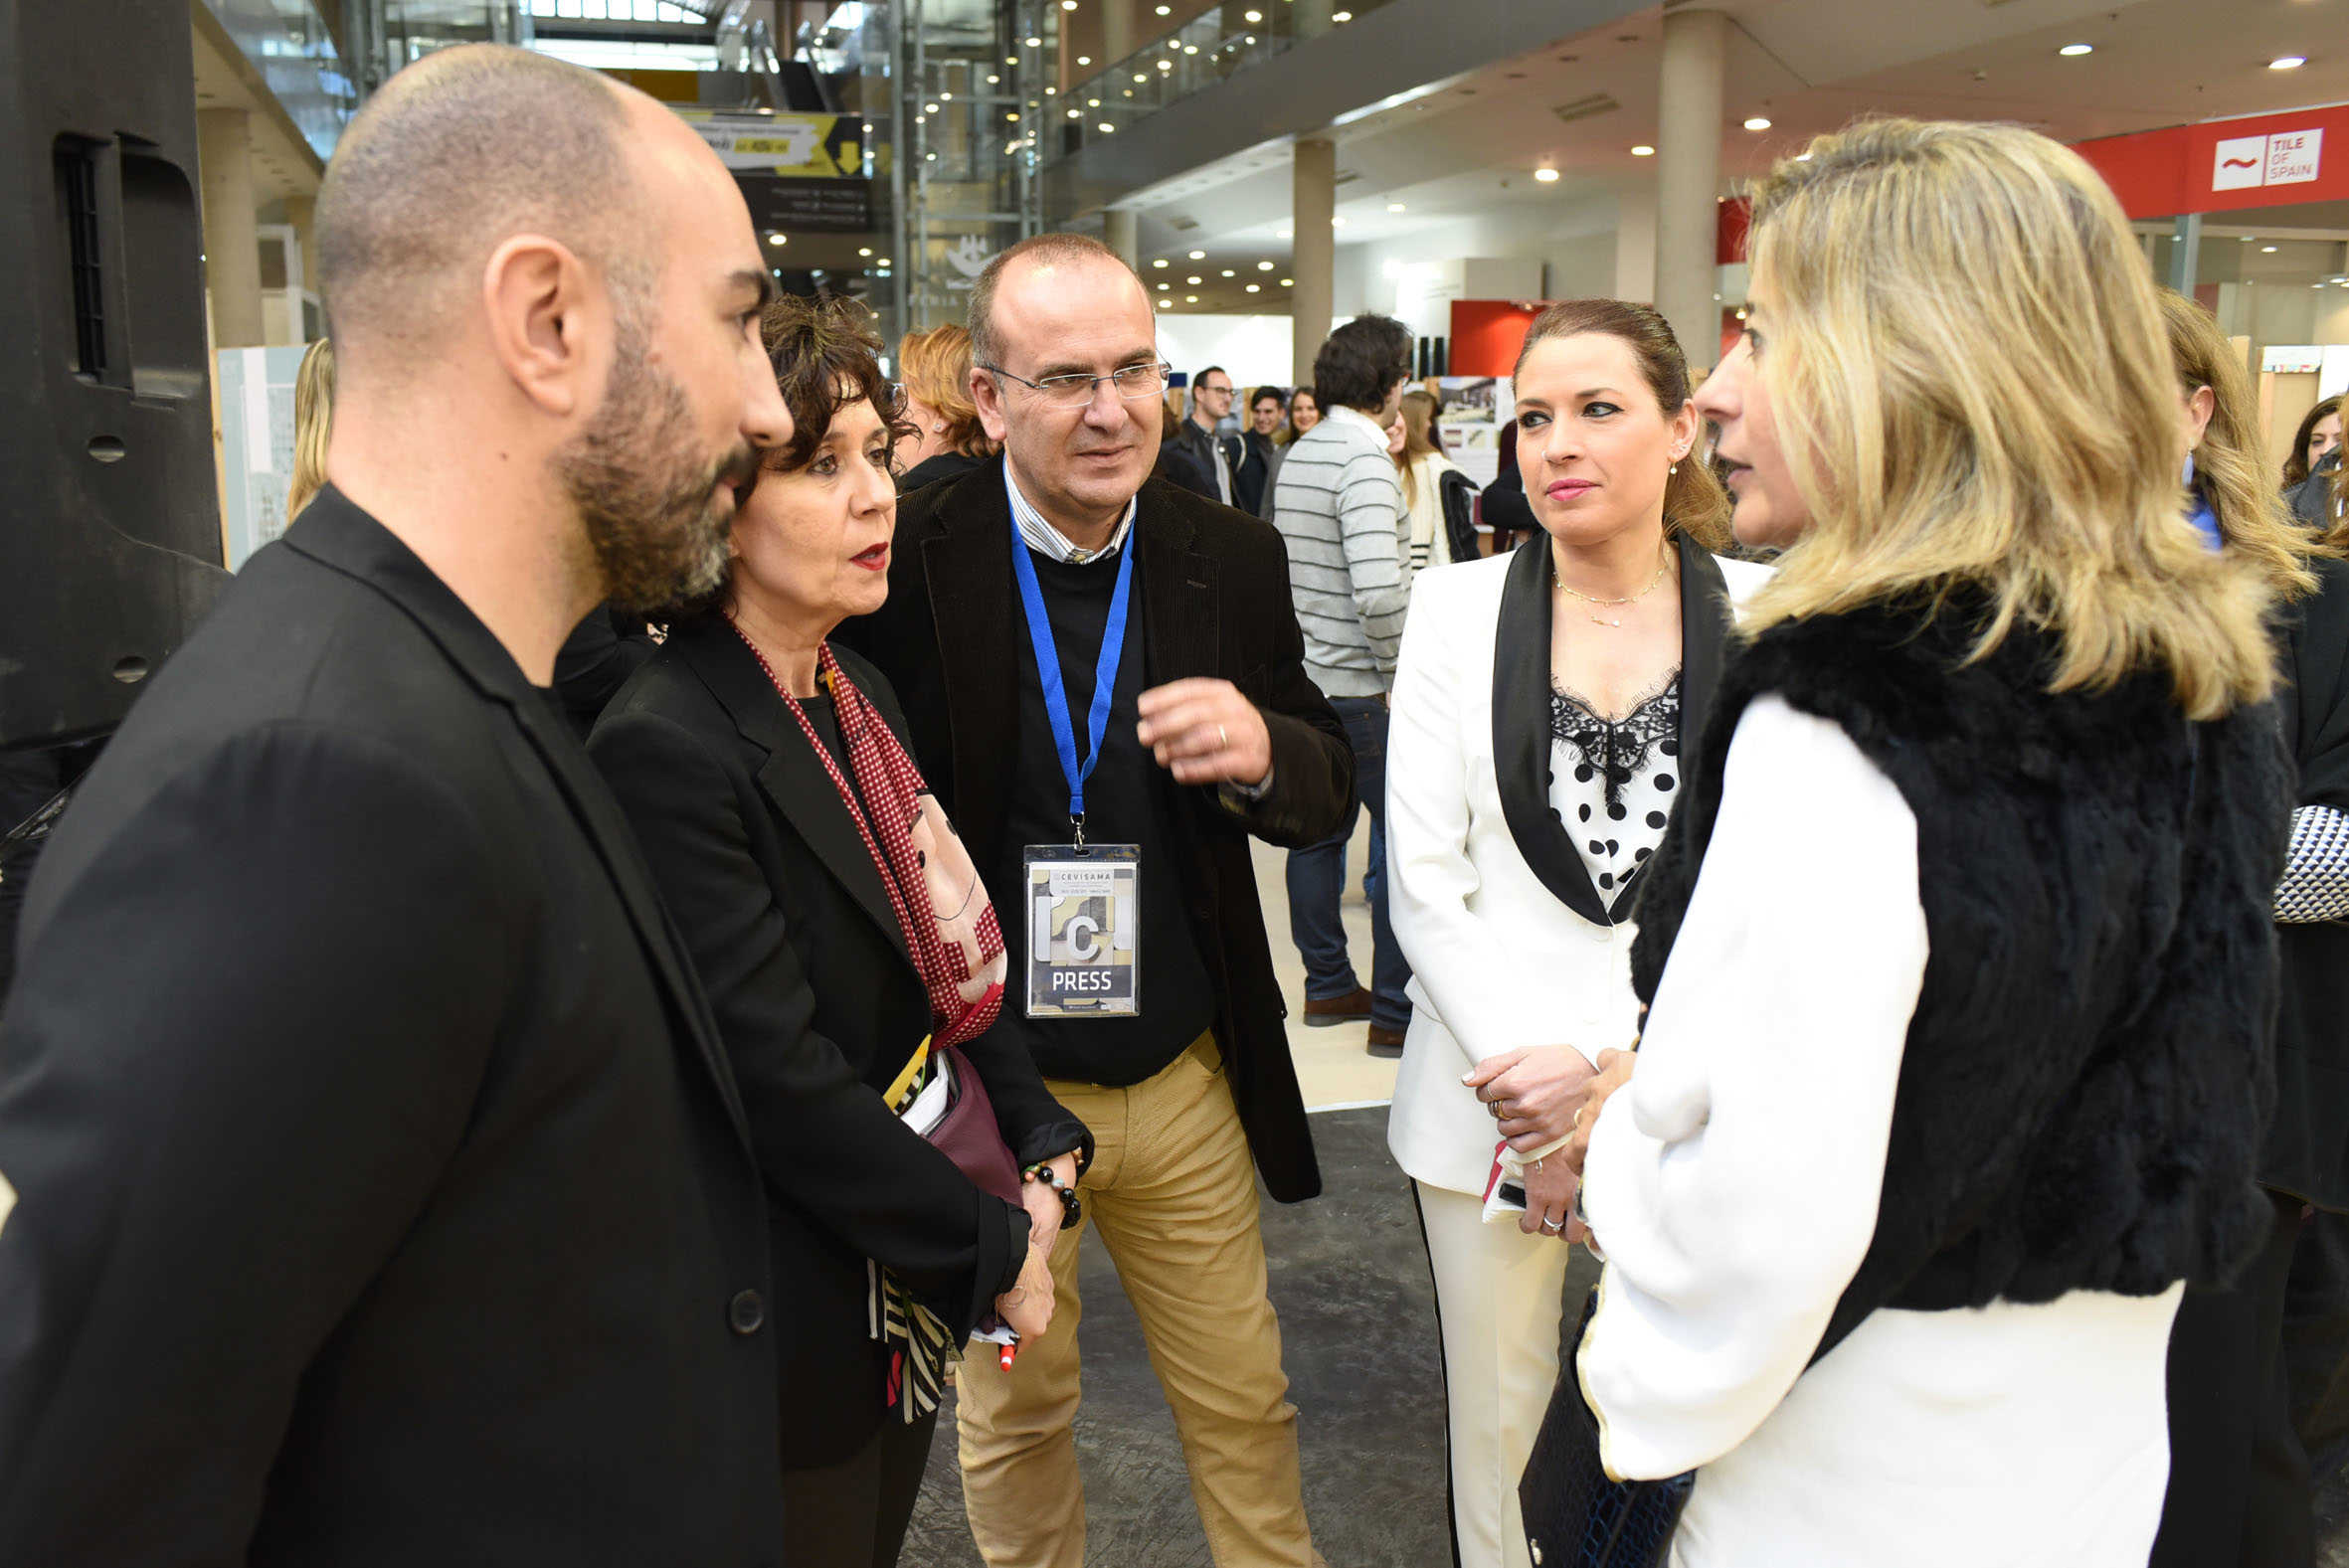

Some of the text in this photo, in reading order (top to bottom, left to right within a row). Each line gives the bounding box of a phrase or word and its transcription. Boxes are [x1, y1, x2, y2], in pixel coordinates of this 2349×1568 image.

[2273, 136, 2304, 151] TILE
[2271, 152, 2290, 165] OF
[2269, 164, 2313, 179] SPAIN
[1067, 916, 1099, 960] C
[1053, 970, 1112, 991] PRESS
